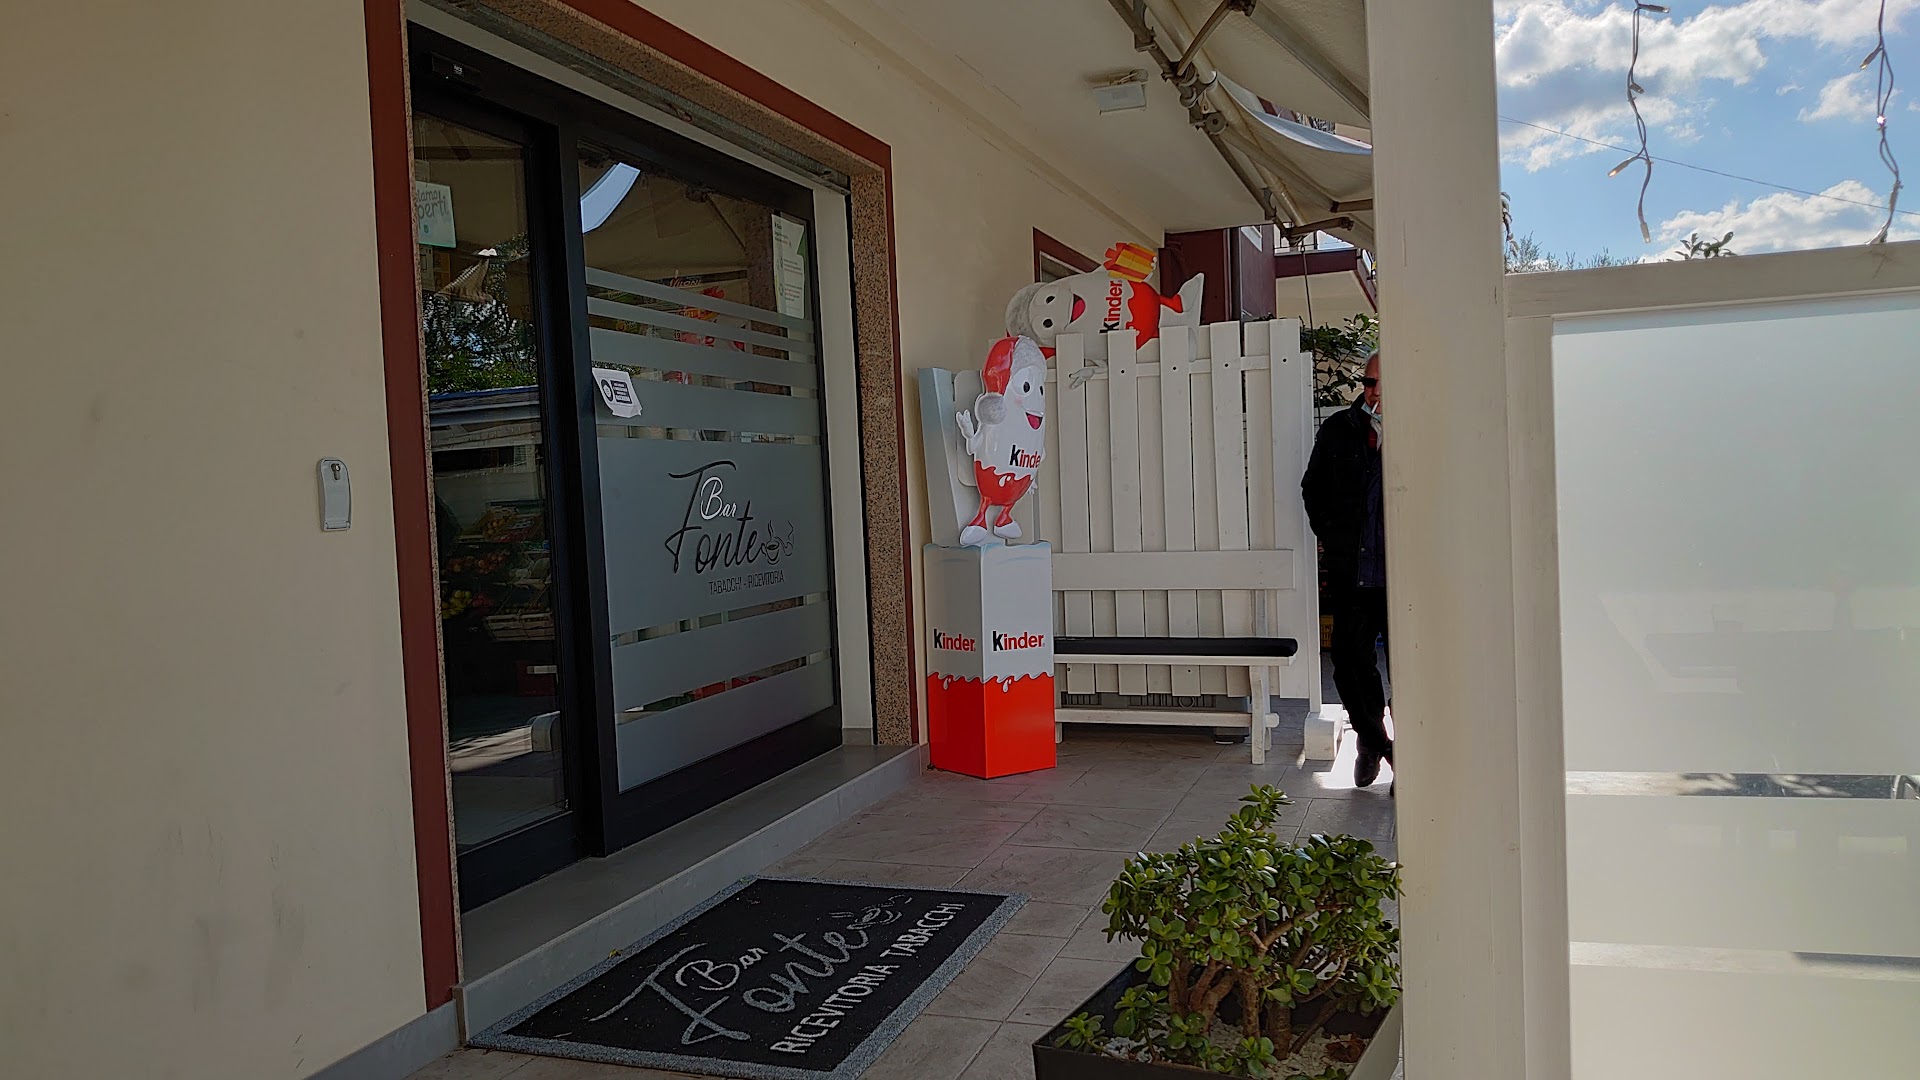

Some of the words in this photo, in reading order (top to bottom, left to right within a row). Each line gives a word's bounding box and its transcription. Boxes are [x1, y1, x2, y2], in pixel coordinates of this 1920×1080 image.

[664, 460, 764, 574] Fonte
[700, 476, 738, 520] Bar
[708, 576, 742, 596] TABACCHI
[747, 569, 785, 589] RICEVITORIA
[588, 929, 870, 1046] Fonte
[675, 945, 769, 991] Bar
[769, 961, 899, 1054] RICEVITORIA
[880, 902, 966, 958] TABACCHI
